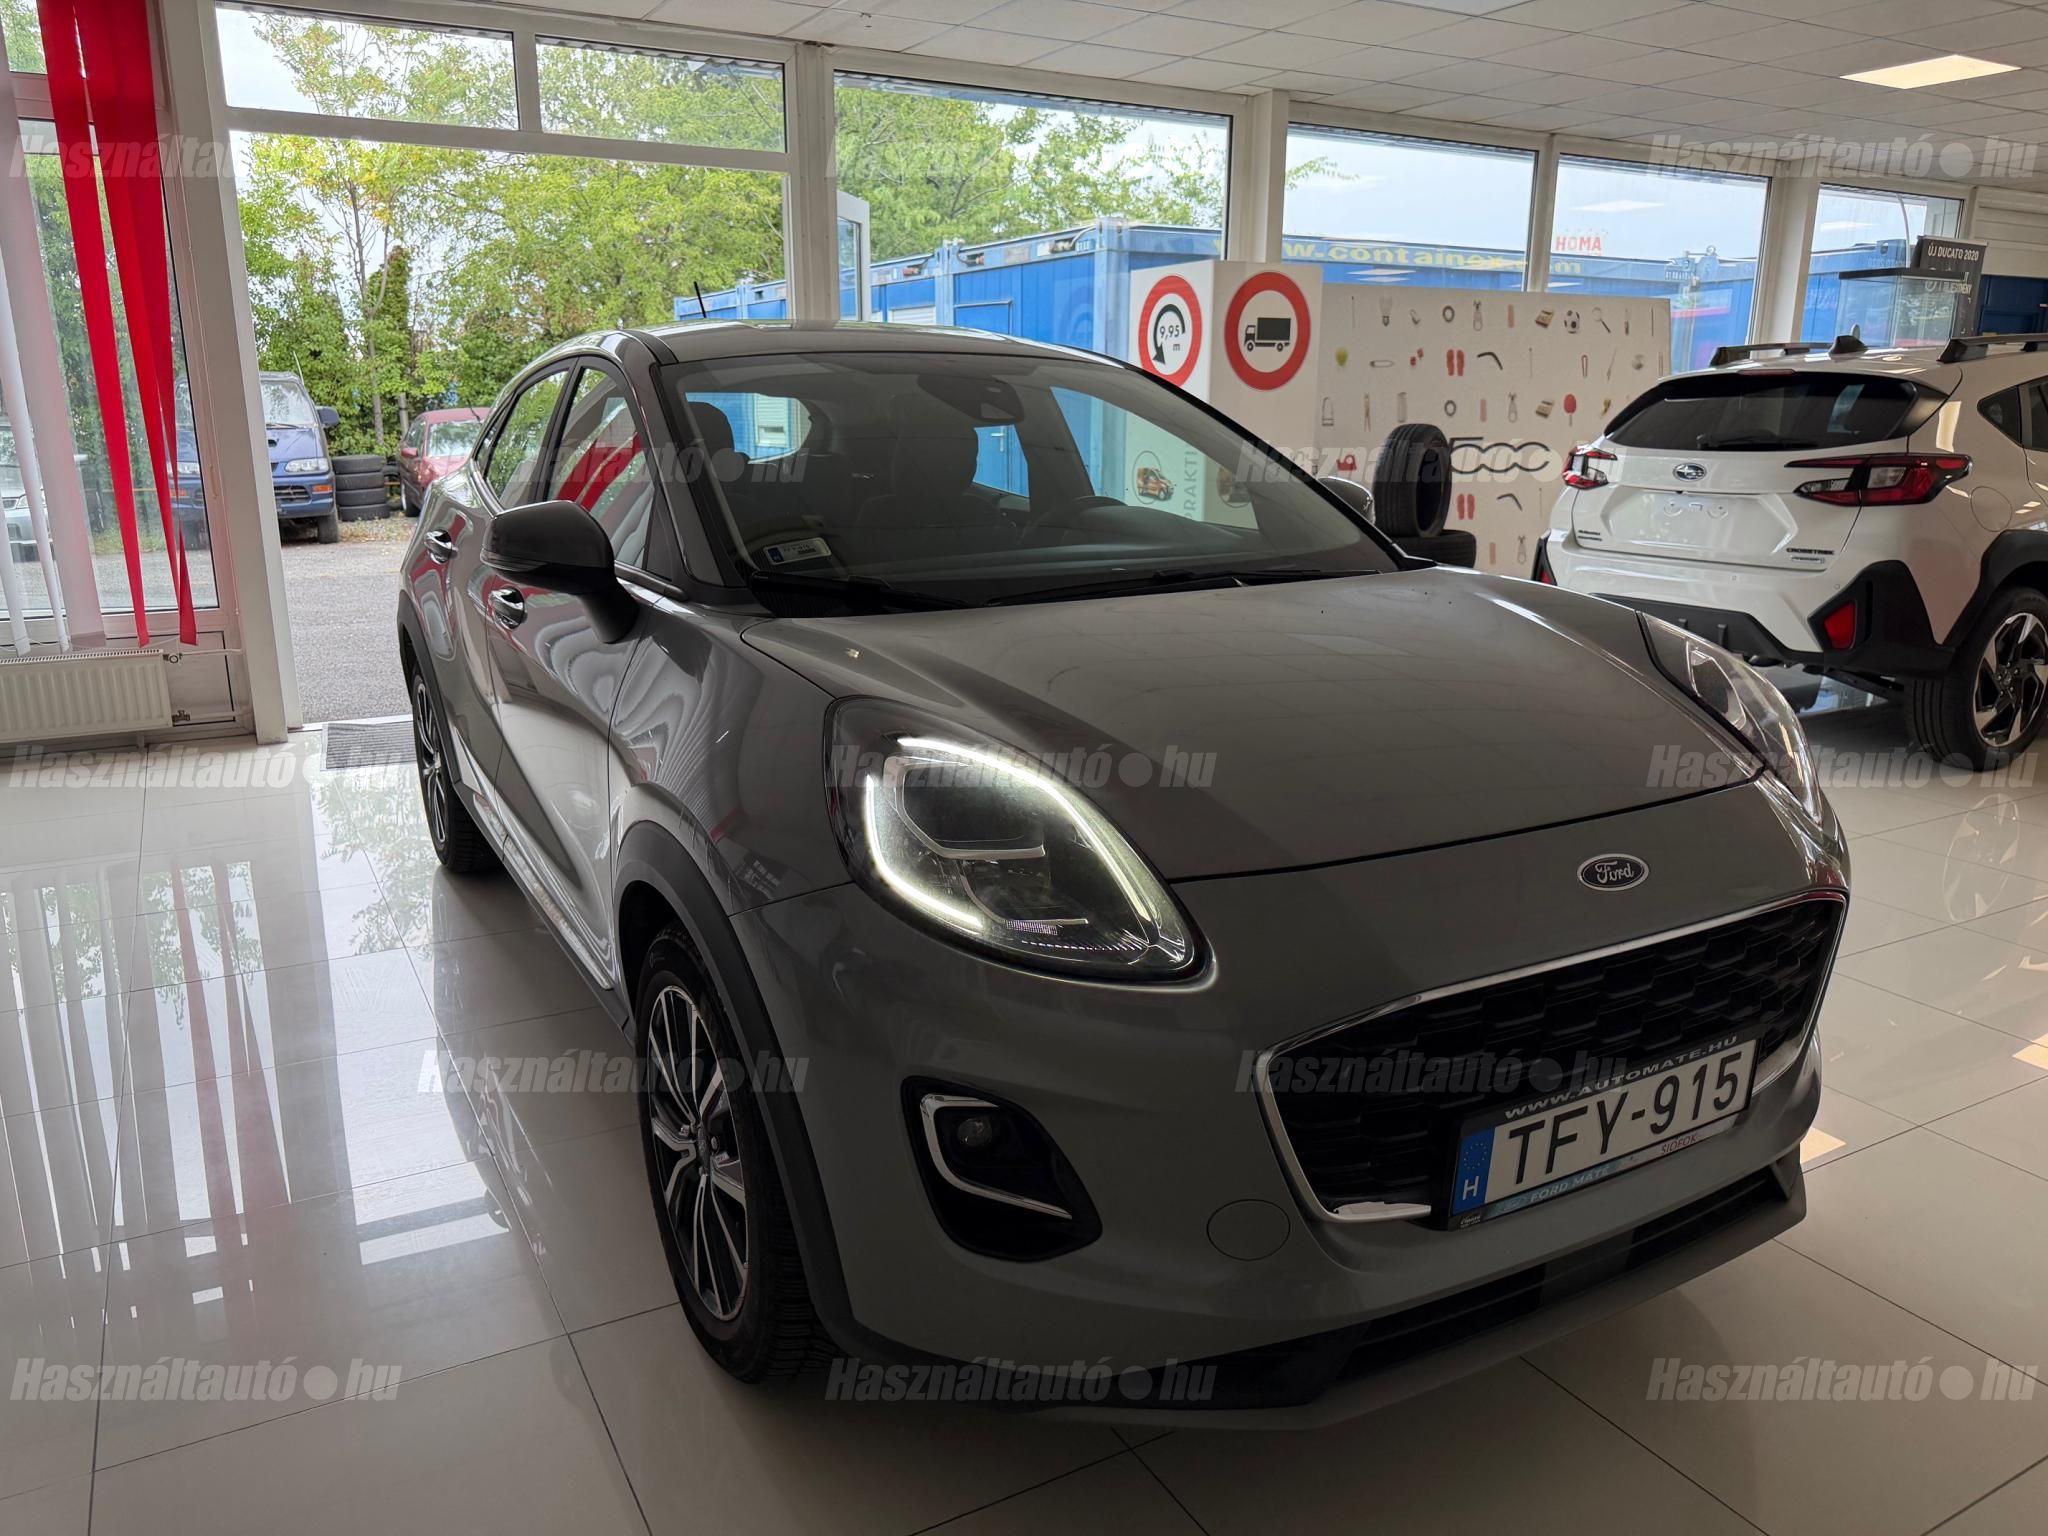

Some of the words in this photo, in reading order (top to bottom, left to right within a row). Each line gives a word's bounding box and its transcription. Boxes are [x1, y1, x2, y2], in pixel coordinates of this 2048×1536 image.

[1556, 236, 1601, 251] HOMA
[1937, 246, 1963, 260] DUCATO
[1963, 248, 1979, 262] 2020
[1159, 325, 1180, 340] 9,95
[1172, 343, 1180, 351] m
[1595, 860, 1634, 884] Ford
[1509, 1051, 1742, 1185] TFY-915
[1462, 1175, 1480, 1200] H
[1530, 1181, 1569, 1203] FORD
